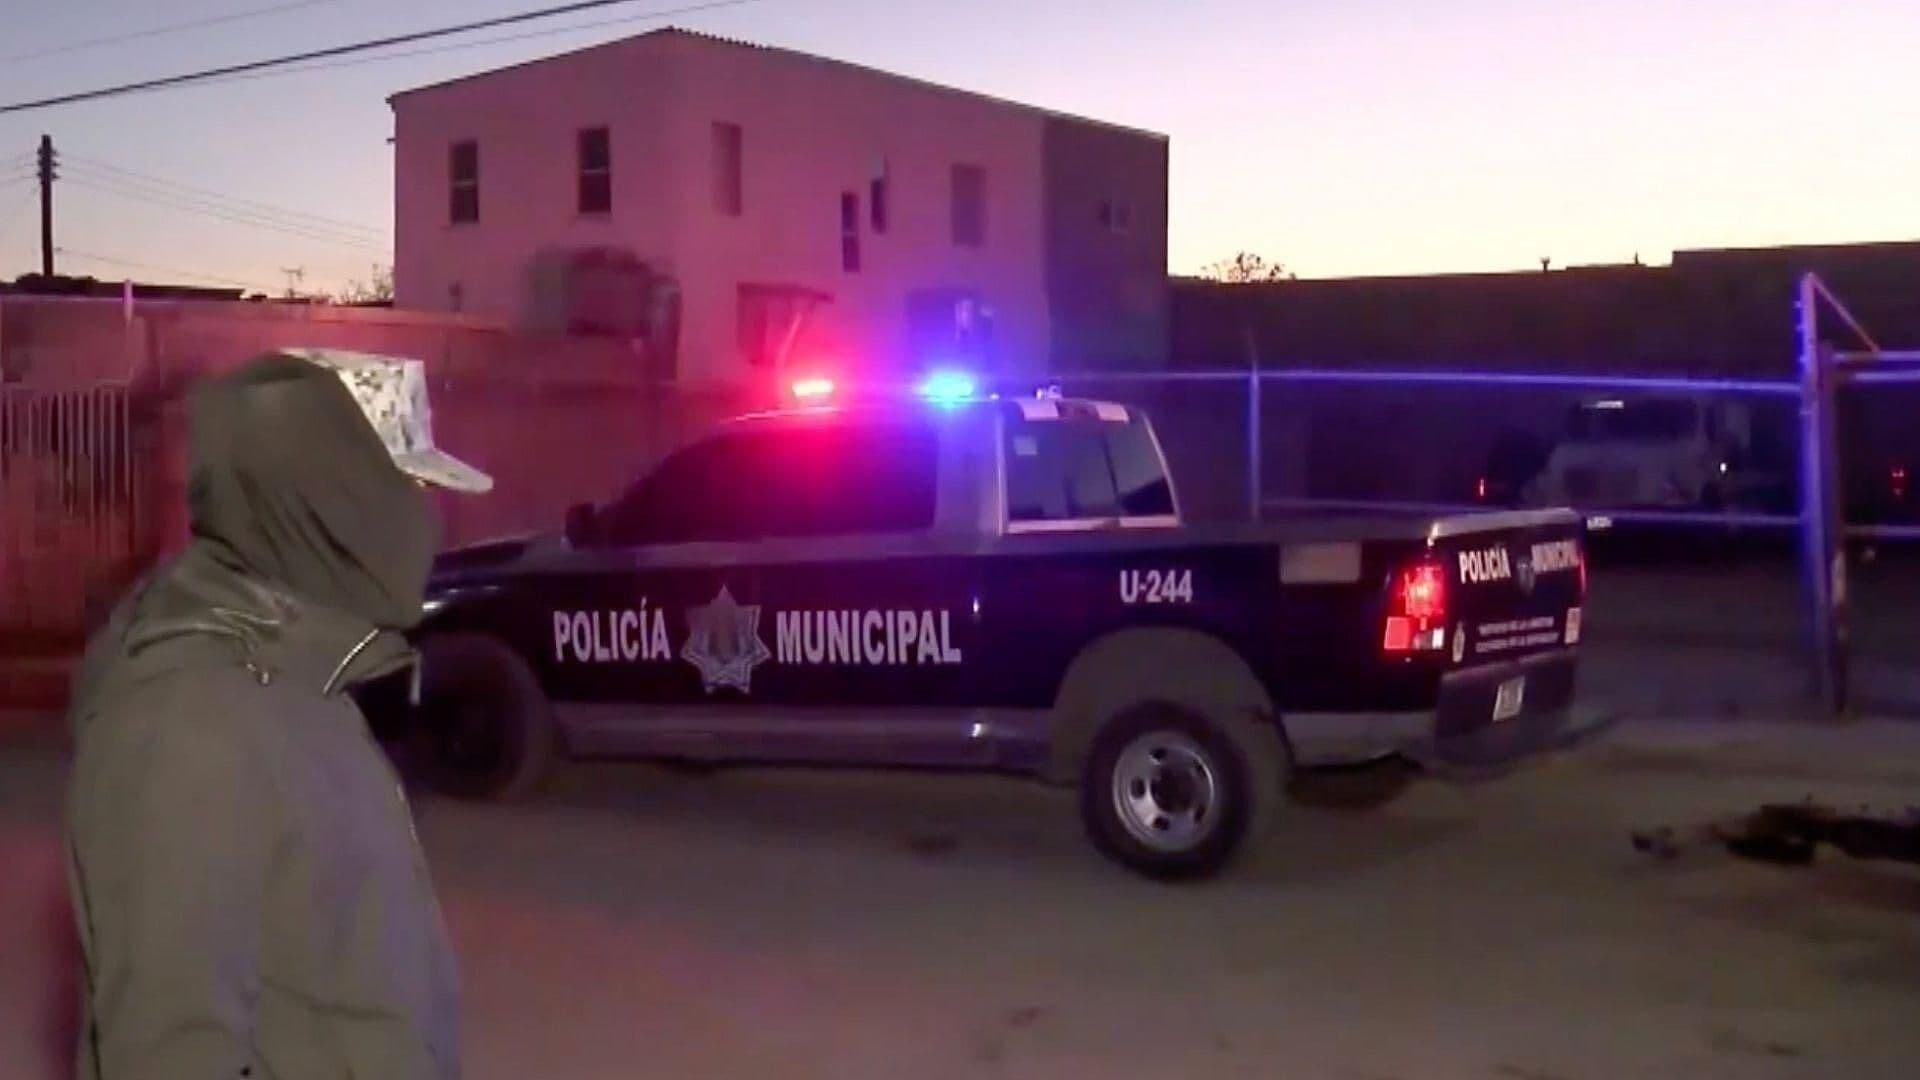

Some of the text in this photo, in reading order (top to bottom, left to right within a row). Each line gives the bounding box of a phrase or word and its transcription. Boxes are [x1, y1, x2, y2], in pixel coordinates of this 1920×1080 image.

[1119, 569, 1194, 604] U-244
[553, 596, 962, 665] POLICÍA MUNICIPAL
